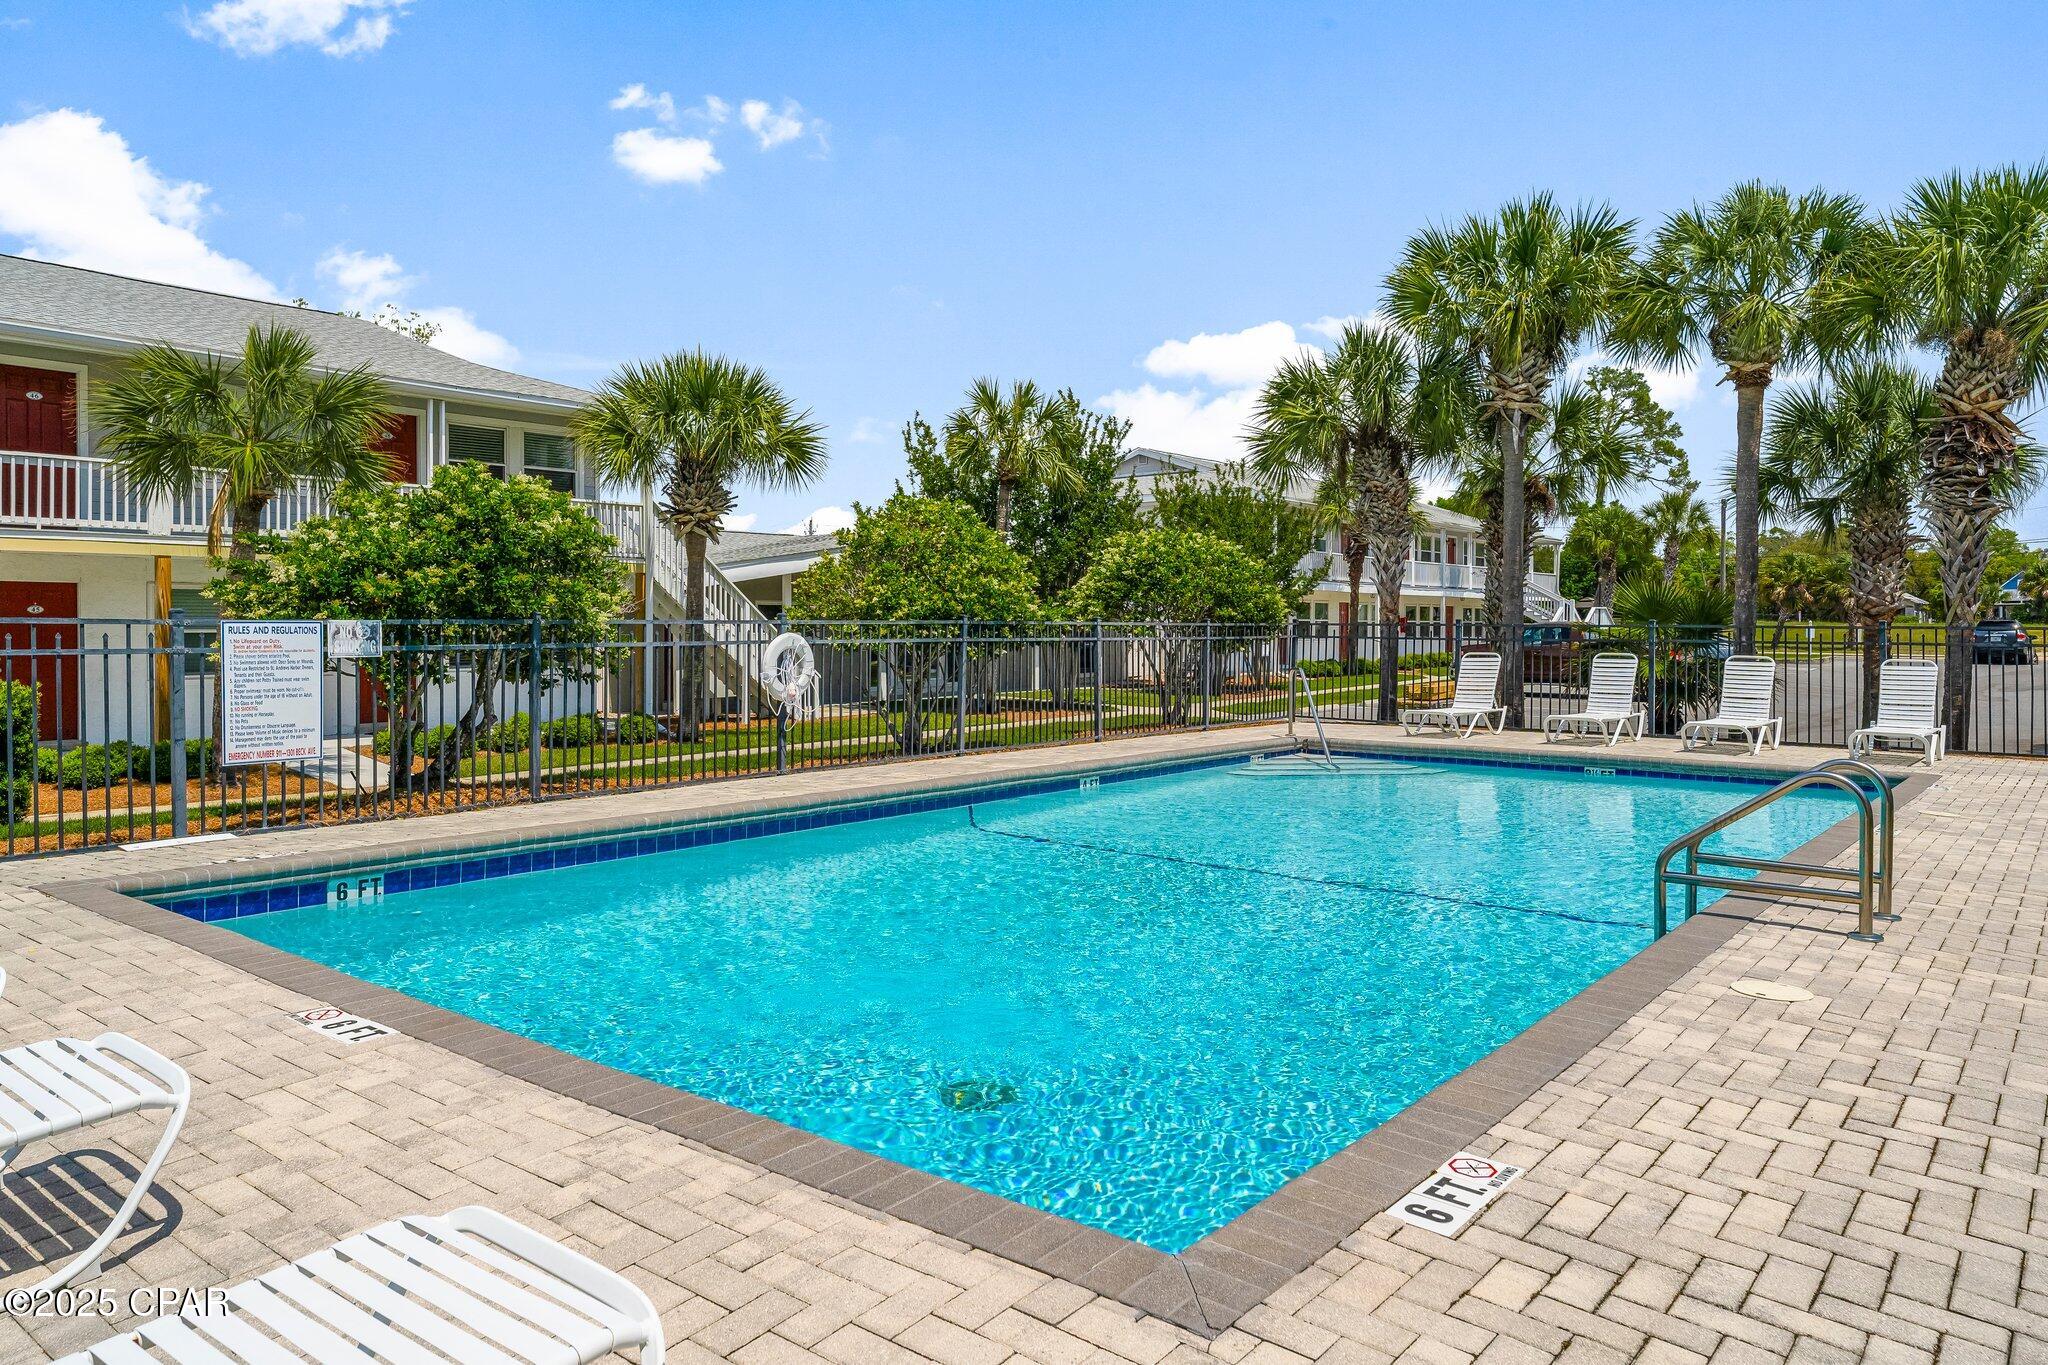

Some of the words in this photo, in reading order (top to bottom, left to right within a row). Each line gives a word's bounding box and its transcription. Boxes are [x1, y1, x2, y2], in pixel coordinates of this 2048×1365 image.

[228, 626, 250, 634] RULES
[253, 626, 269, 634] AND
[272, 626, 318, 634] REGULATIONS
[340, 625, 352, 638] NO
[229, 751, 255, 760] EMERGENCY
[256, 750, 274, 759] NUMBER
[296, 748, 306, 756] BECK
[337, 882, 348, 900] 6
[358, 877, 382, 898] FT.
[322, 1020, 358, 1029] 6
[1487, 1179, 1503, 1188] NO
[1495, 1166, 1518, 1181] DIVING
[1423, 1177, 1488, 1208] FT.
[1404, 1204, 1454, 1223] 6
